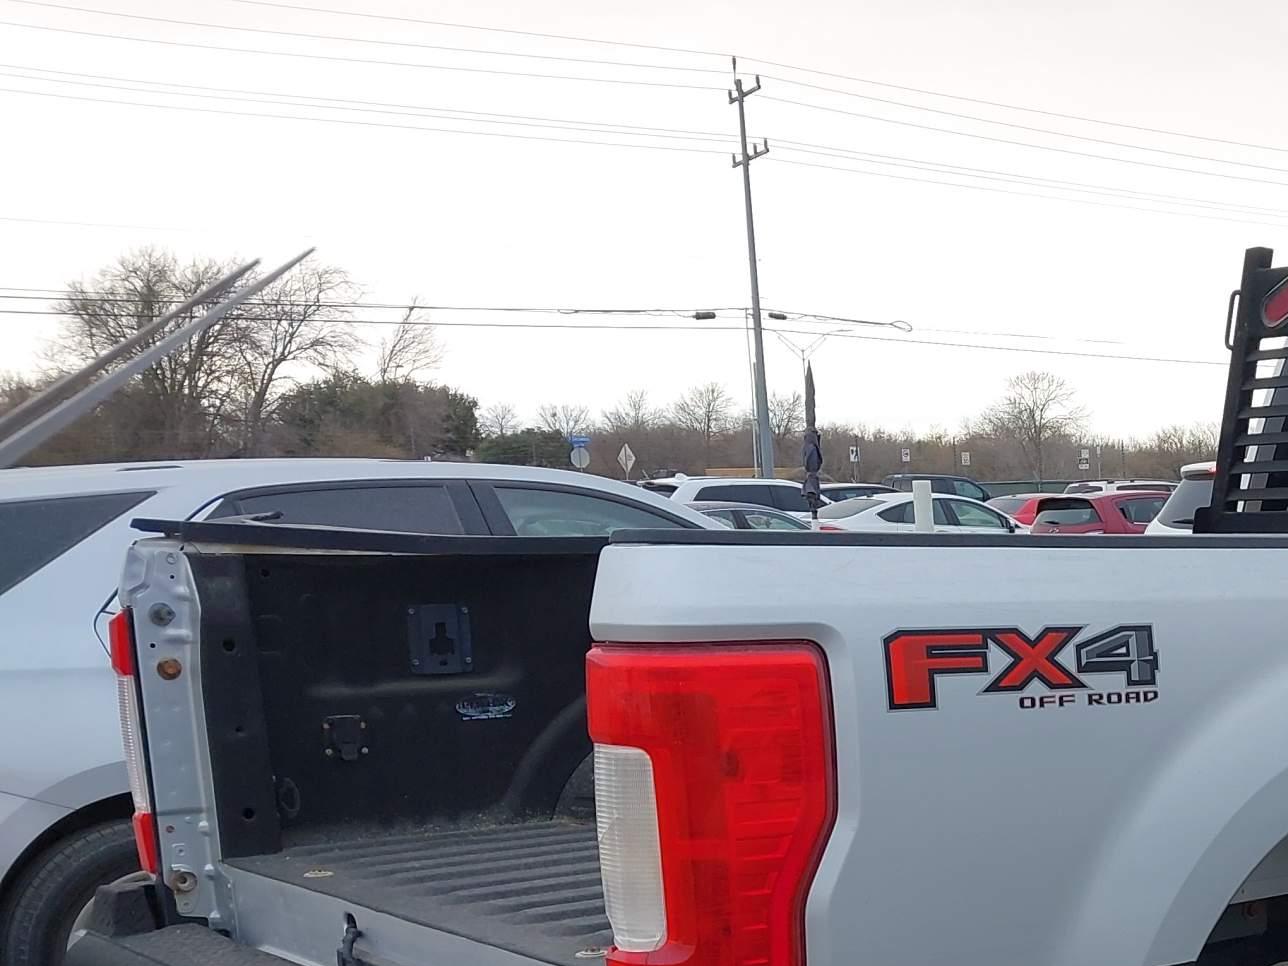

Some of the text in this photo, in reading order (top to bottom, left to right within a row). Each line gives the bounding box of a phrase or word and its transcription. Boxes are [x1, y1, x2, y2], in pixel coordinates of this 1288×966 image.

[883, 625, 1159, 710] FX4
[1019, 690, 1159, 709] OFF ROAD
